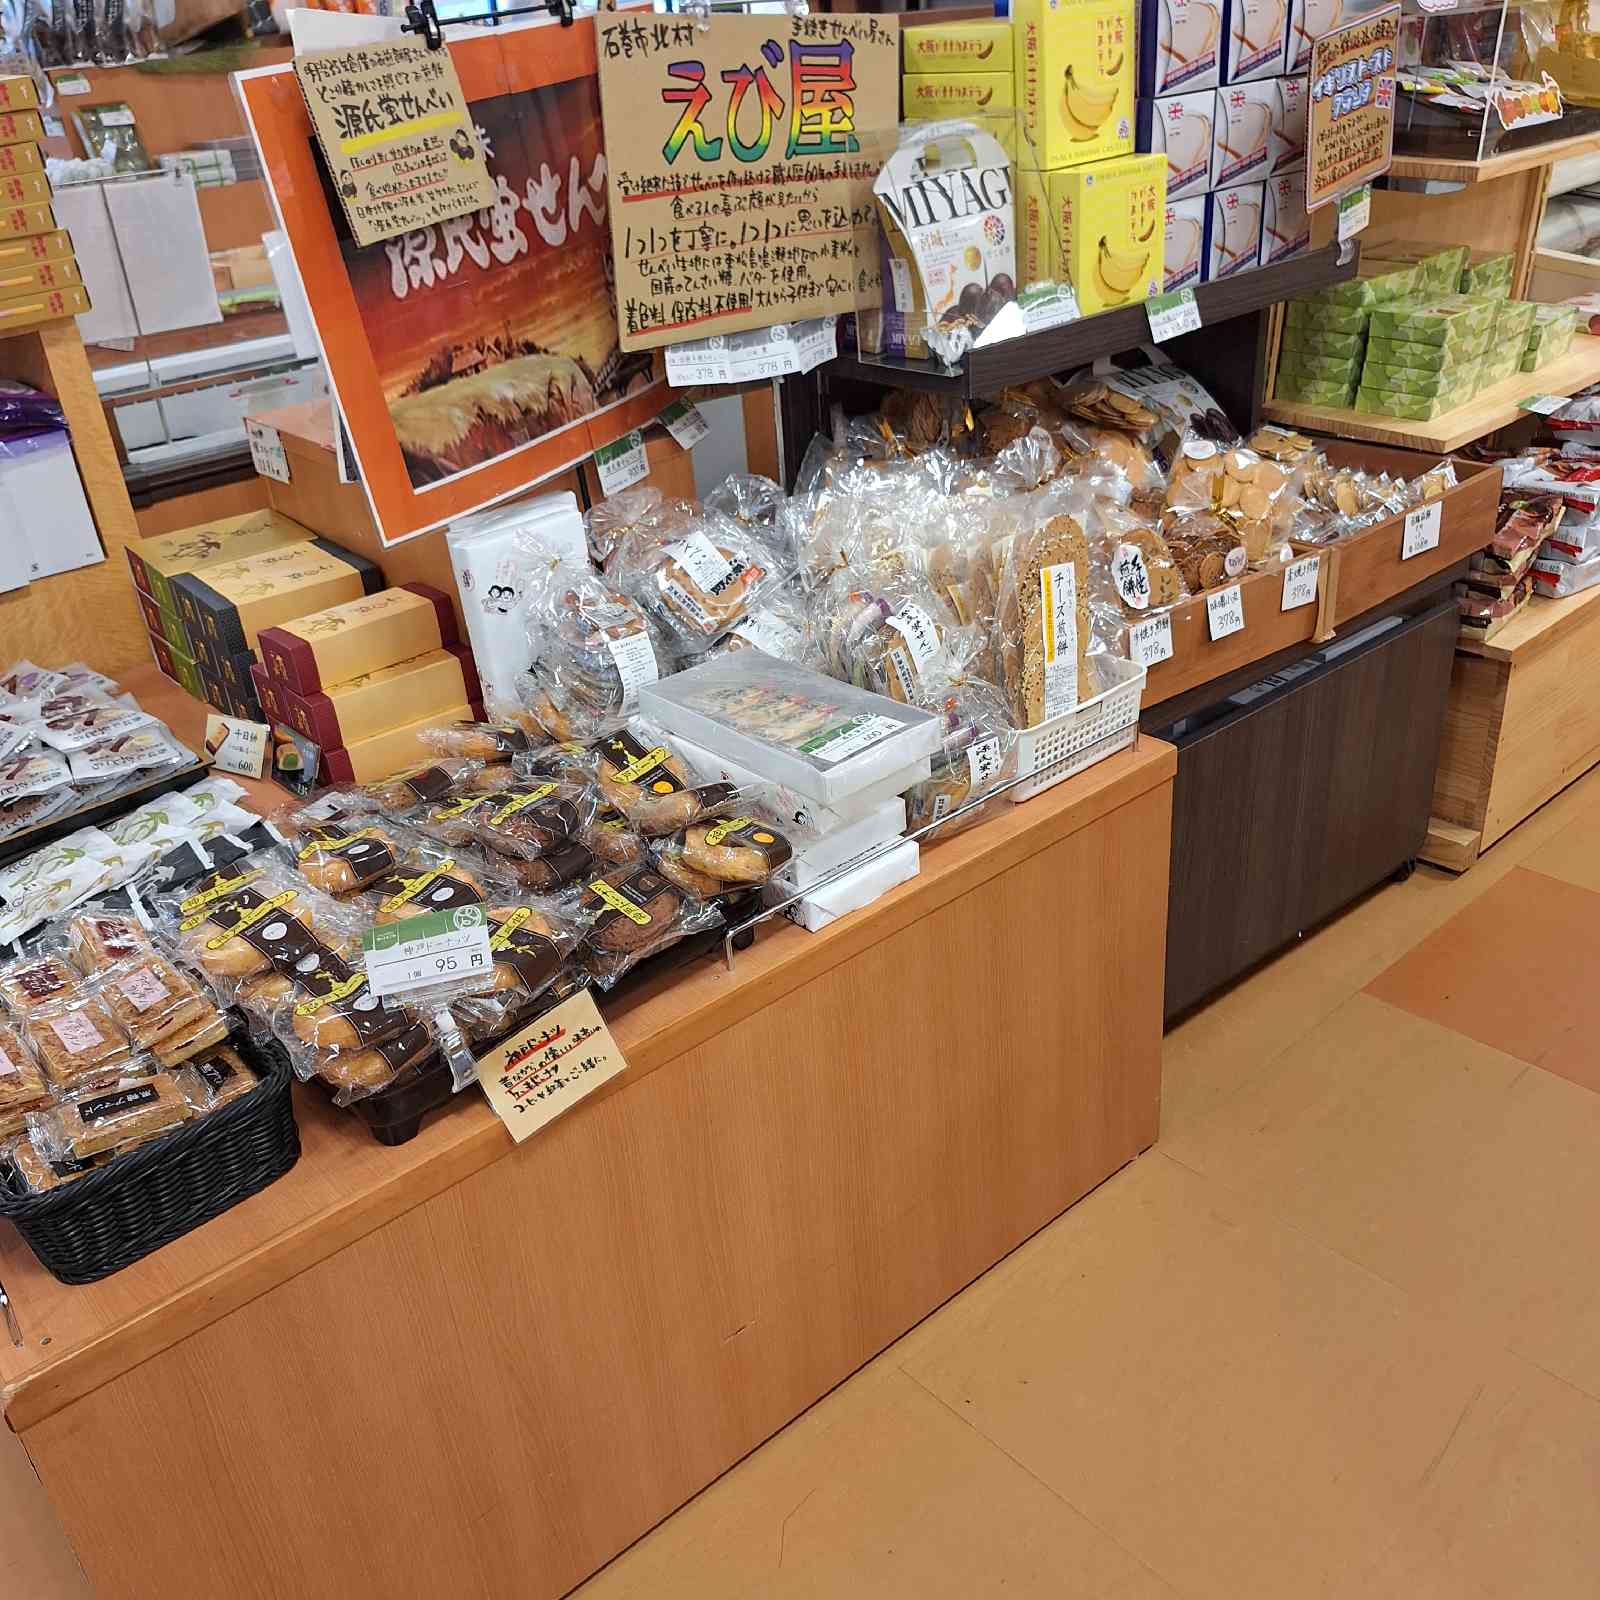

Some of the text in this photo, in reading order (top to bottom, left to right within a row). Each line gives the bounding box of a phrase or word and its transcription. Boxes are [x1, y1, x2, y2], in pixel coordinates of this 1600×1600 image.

[661, 38, 860, 165] えび屋
[881, 166, 1012, 232] MIYAGI
[1054, 571, 1069, 657] チーズ煎餅
[435, 956, 458, 972] 95
[470, 953, 484, 968] 円
